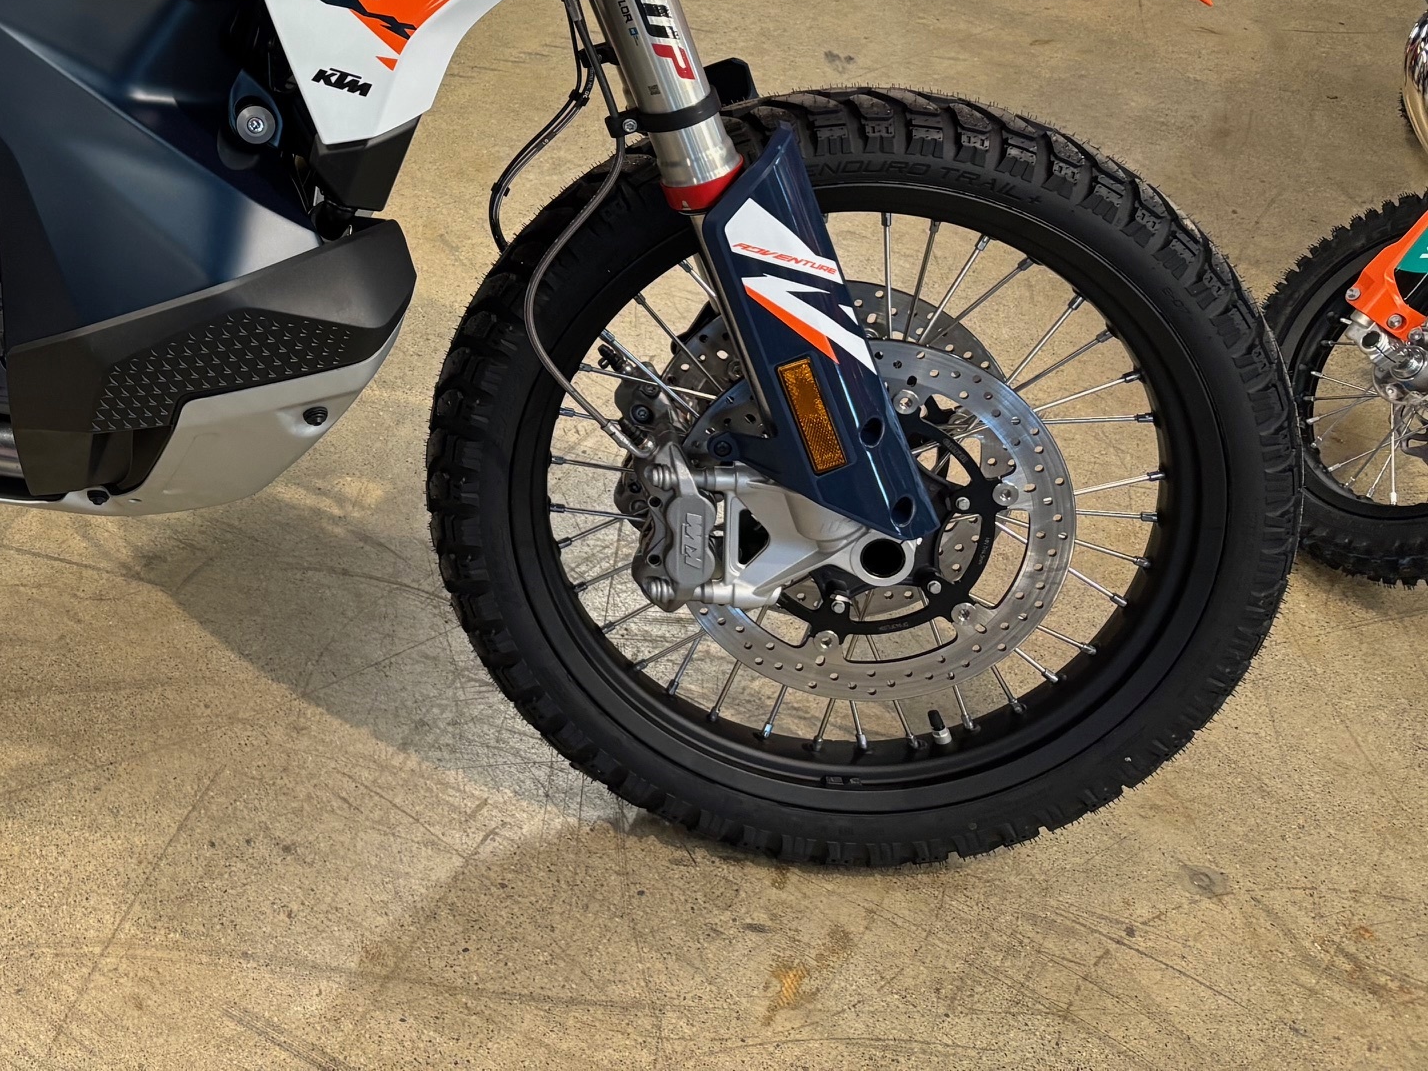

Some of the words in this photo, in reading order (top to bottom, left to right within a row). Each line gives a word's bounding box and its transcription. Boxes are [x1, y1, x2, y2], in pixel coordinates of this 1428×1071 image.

[311, 67, 373, 97] KTM
[732, 242, 837, 275] ADVENTURE
[681, 512, 703, 570] KTM
